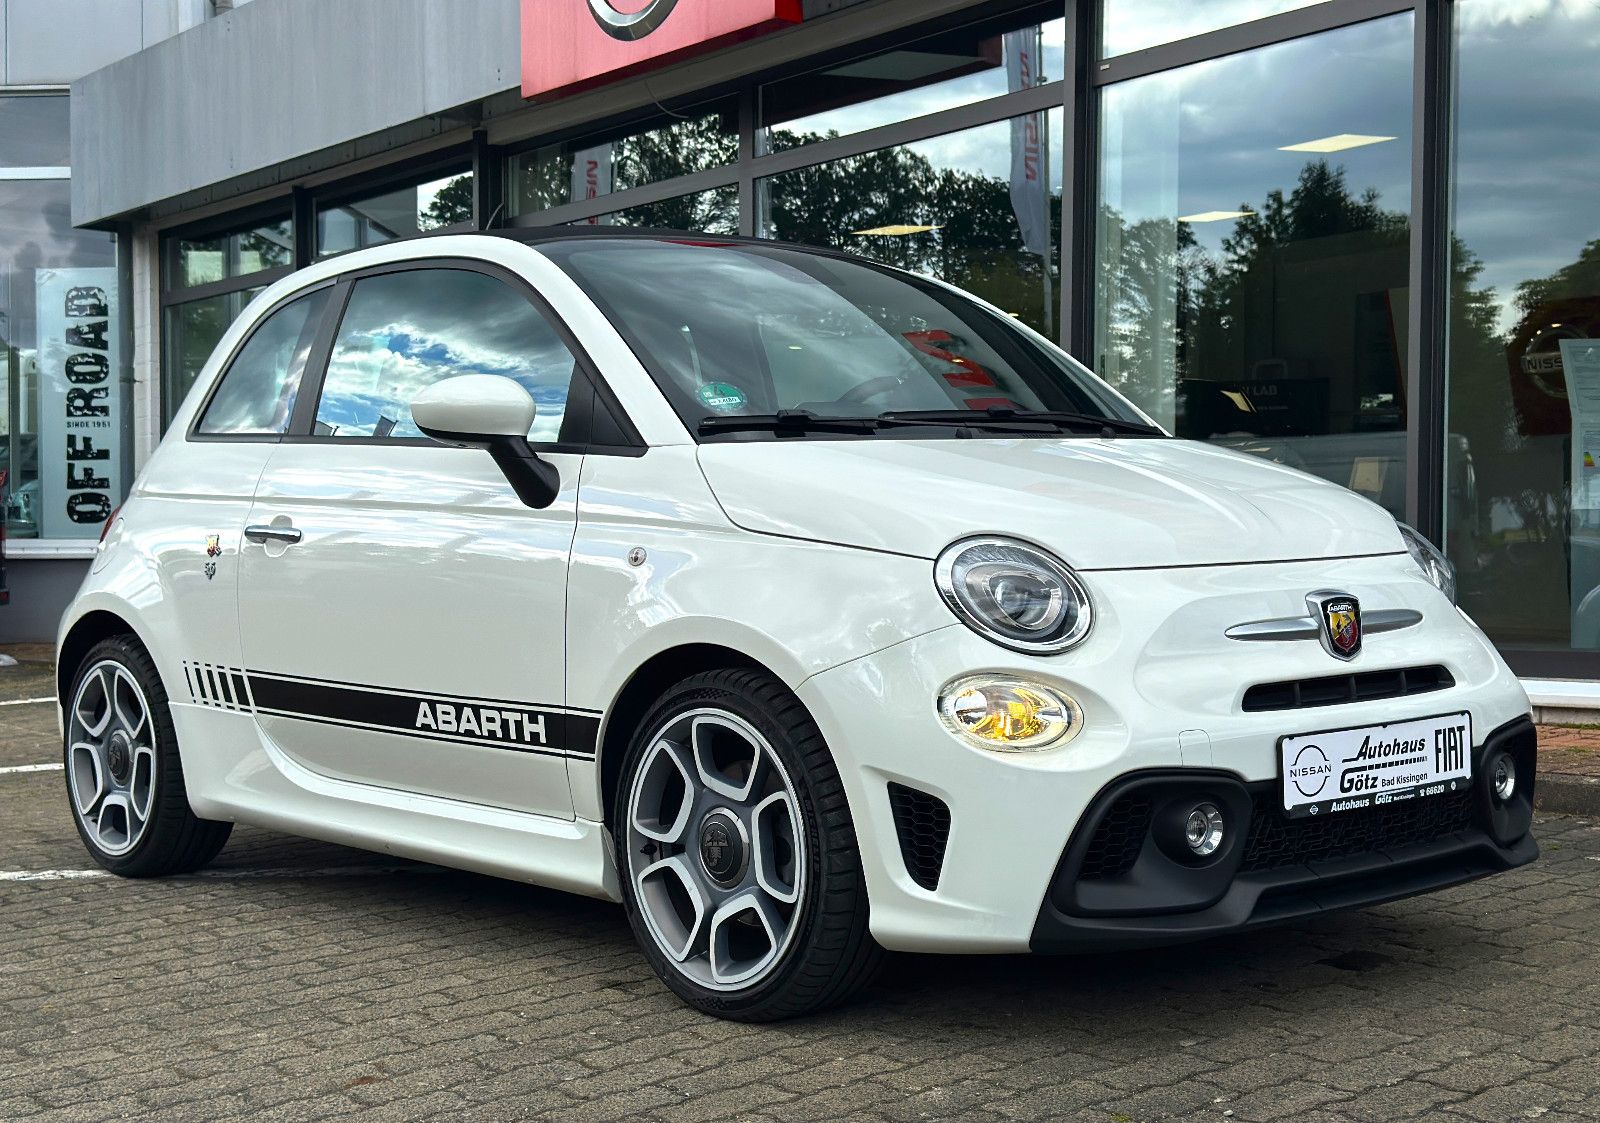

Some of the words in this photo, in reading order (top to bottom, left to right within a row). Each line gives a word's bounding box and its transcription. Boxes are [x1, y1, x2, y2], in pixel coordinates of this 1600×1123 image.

[65, 286, 110, 418] ROAD
[66, 434, 112, 524] OFF
[1330, 603, 1353, 612] ABARTH
[415, 701, 547, 744] ABARTH
[1342, 735, 1426, 763] Autohaus
[1434, 725, 1466, 774] FIAT
[1290, 764, 1332, 778] NISSAN
[1340, 767, 1379, 793] Götz
[1381, 778, 1395, 788] Bad
[1396, 772, 1428, 784] Kissingen
[1330, 798, 1370, 812] Autohaus
[1375, 792, 1392, 805] Götz
